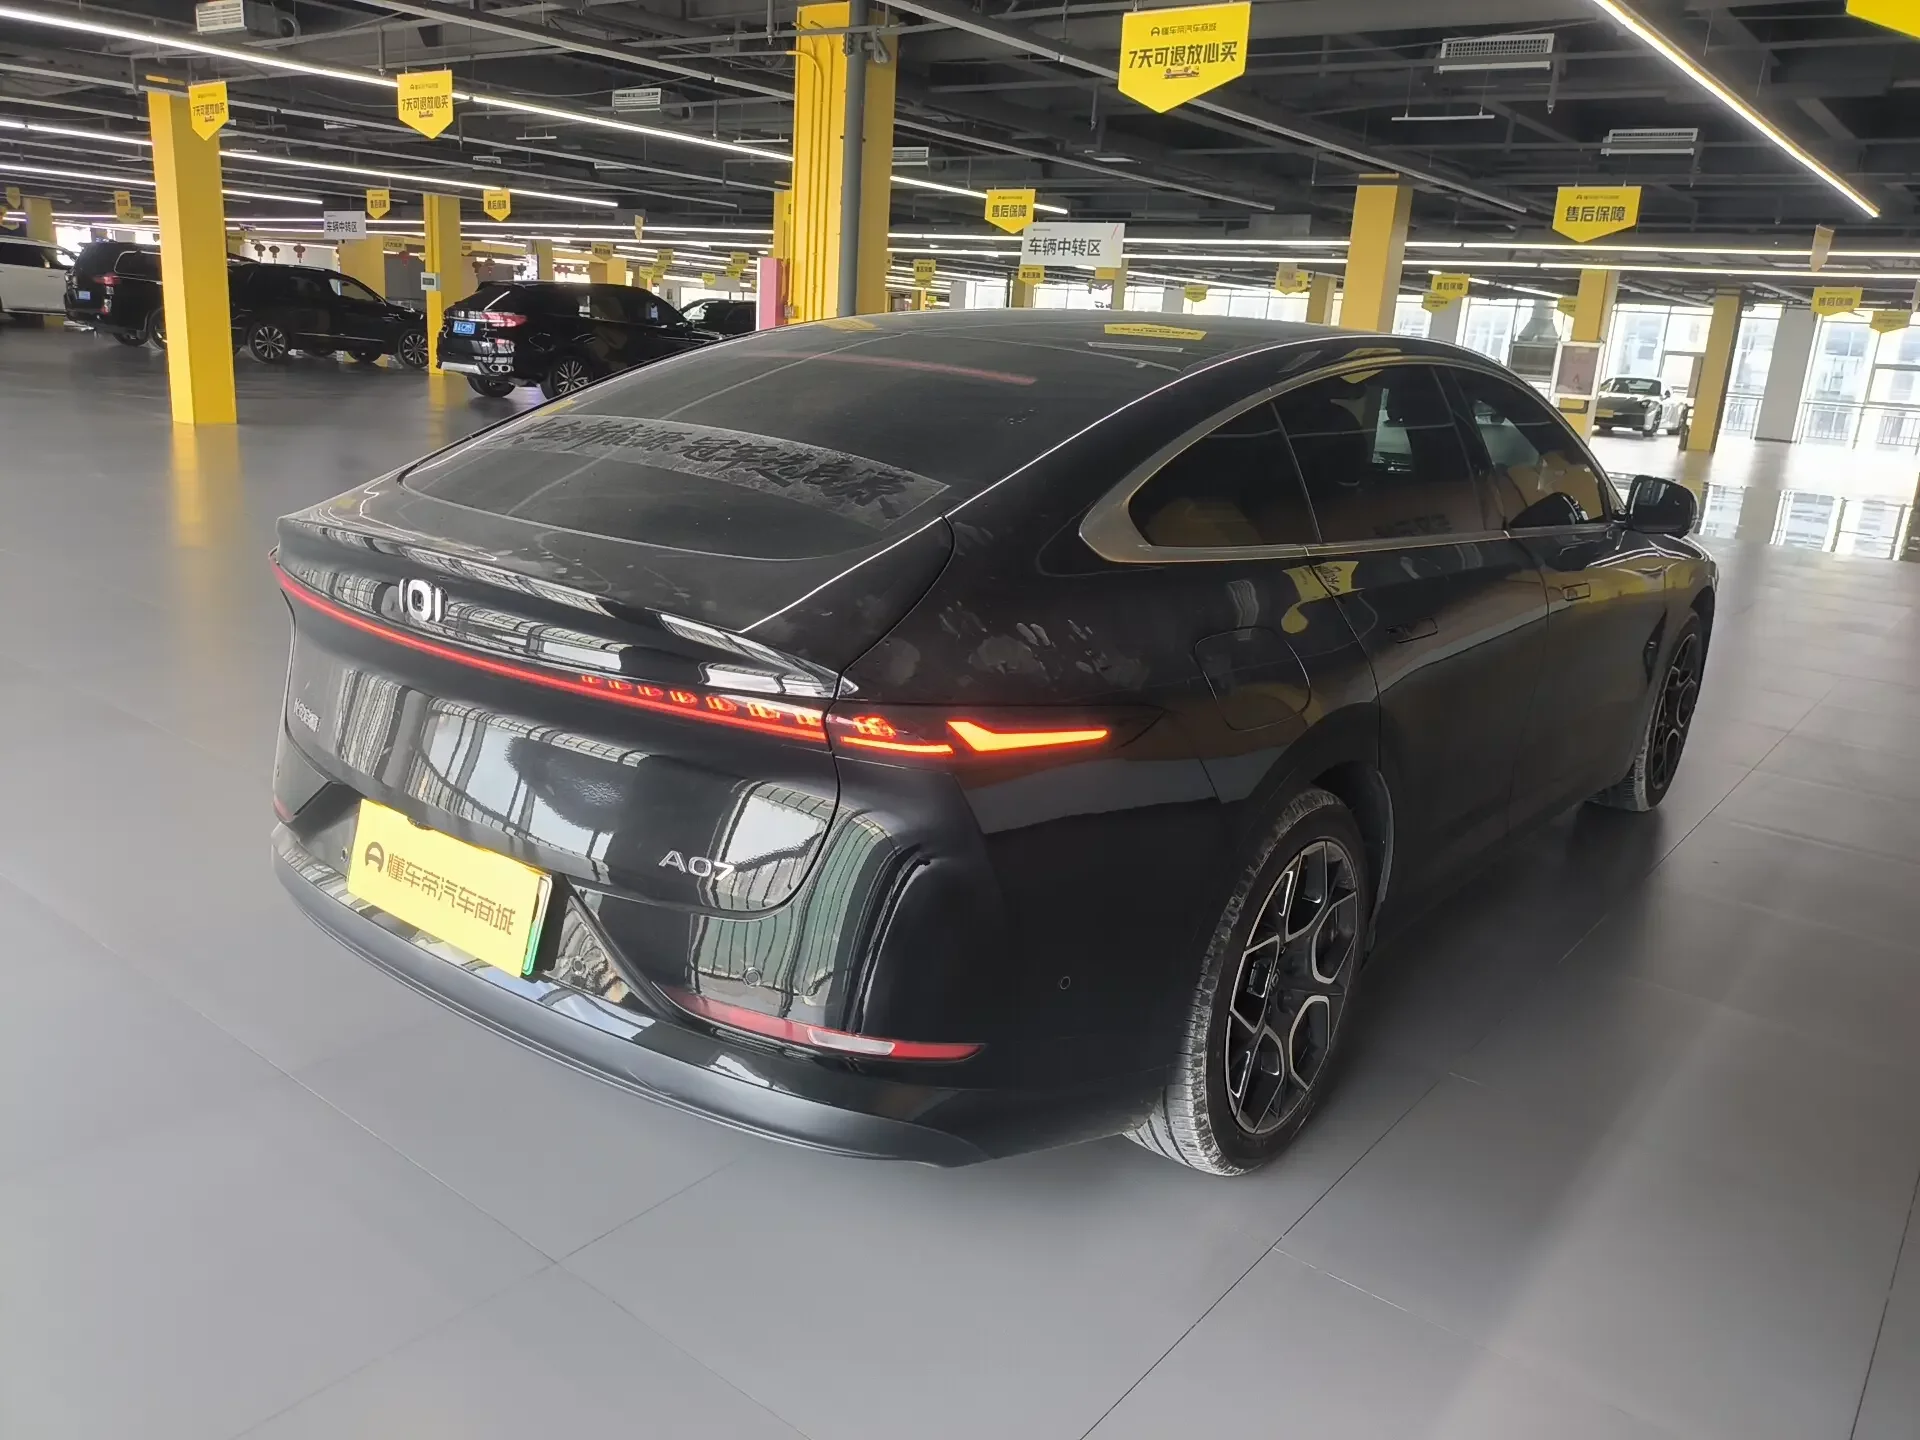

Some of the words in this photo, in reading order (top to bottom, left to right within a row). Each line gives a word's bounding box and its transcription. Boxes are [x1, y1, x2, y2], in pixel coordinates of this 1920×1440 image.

[1128, 41, 1238, 69] 7天可退放心买
[991, 204, 1028, 218] 售后保障
[1565, 205, 1626, 222] 售后保障
[1028, 236, 1102, 257] 车辆中转区
[658, 850, 735, 881] A07
[386, 852, 516, 936] 懂车帝汽车商城
